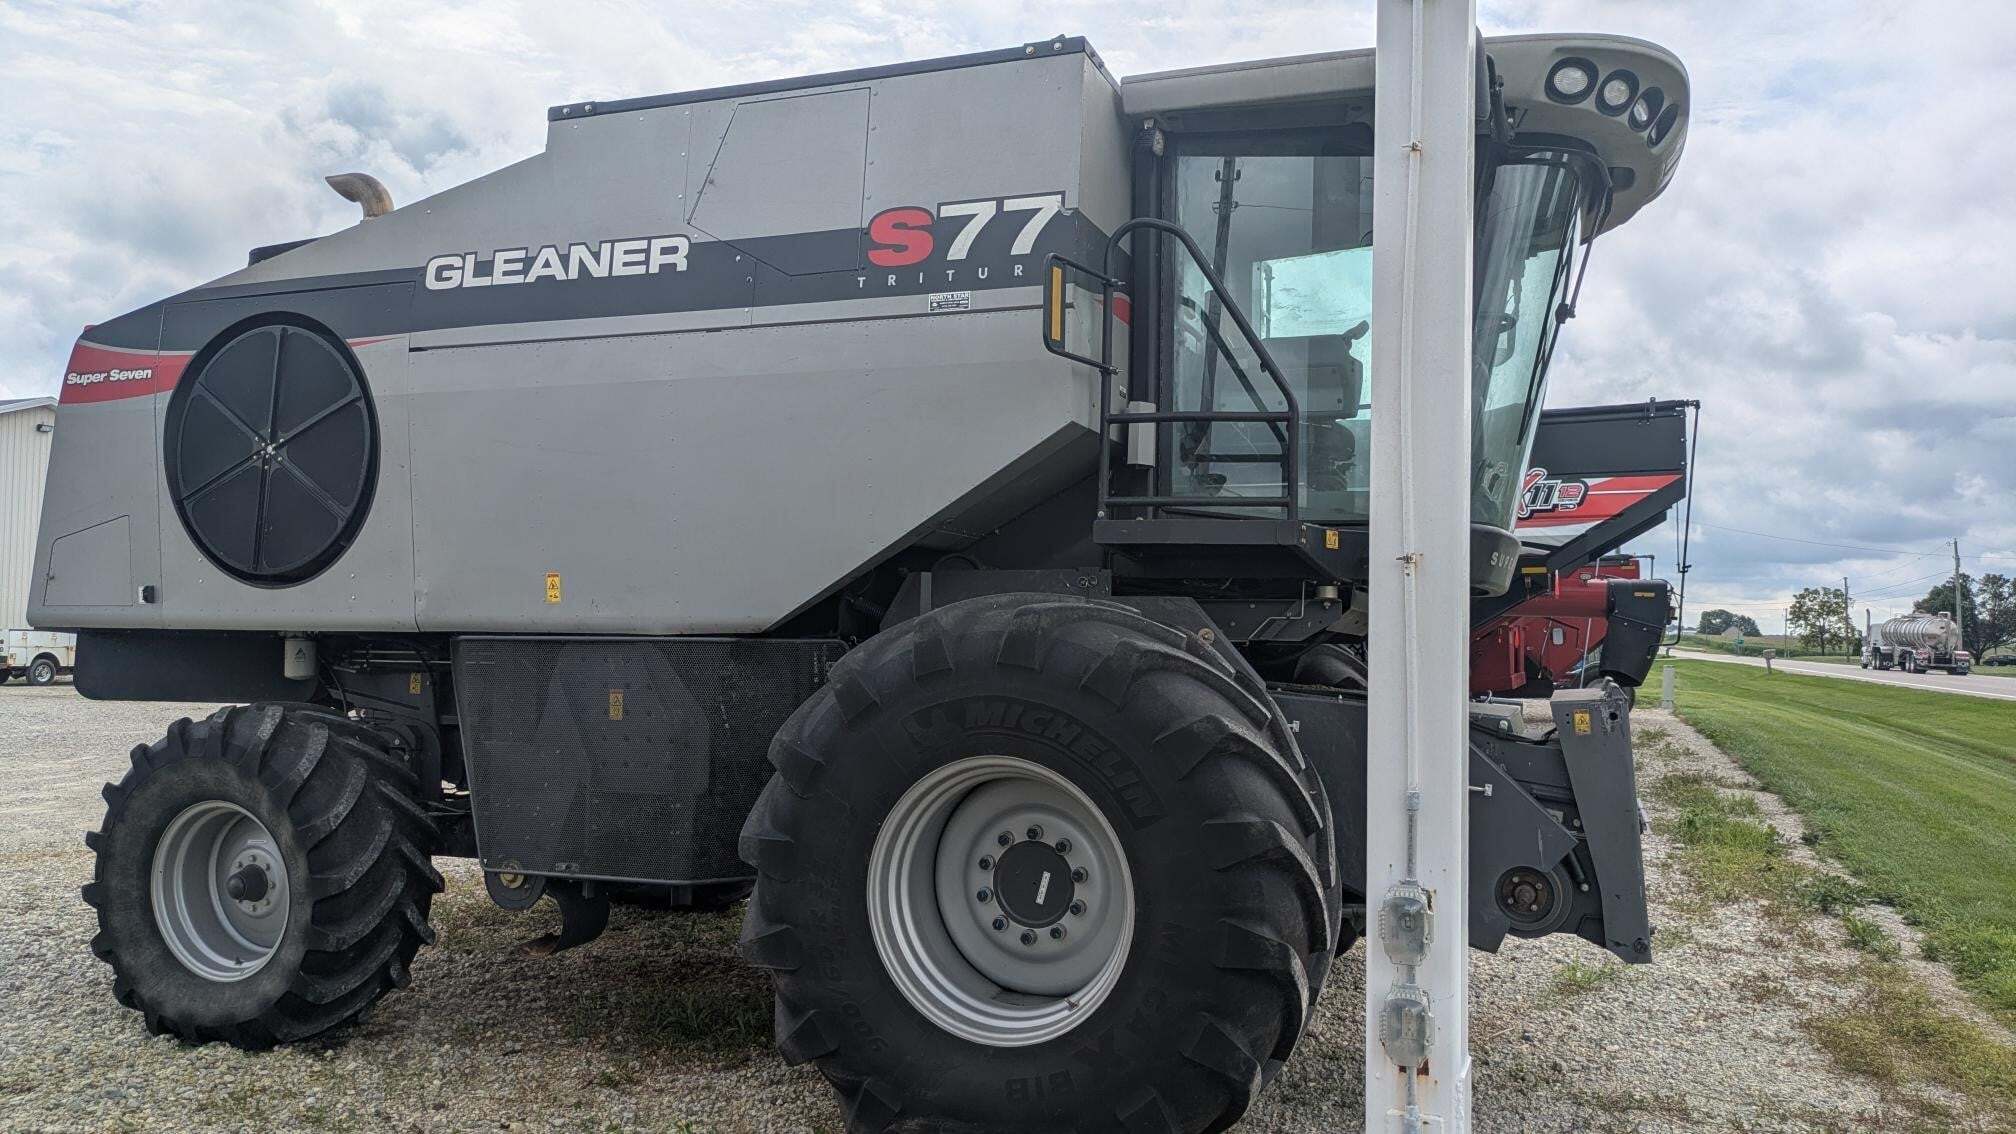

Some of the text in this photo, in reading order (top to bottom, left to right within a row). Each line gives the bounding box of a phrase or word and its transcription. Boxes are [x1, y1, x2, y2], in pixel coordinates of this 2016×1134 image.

[868, 194, 1062, 267] S77
[425, 236, 689, 290] GLEANER
[930, 292, 969, 302] NORTH STAR
[67, 369, 152, 386] Super Seven
[961, 700, 1162, 820] MICHELIN
